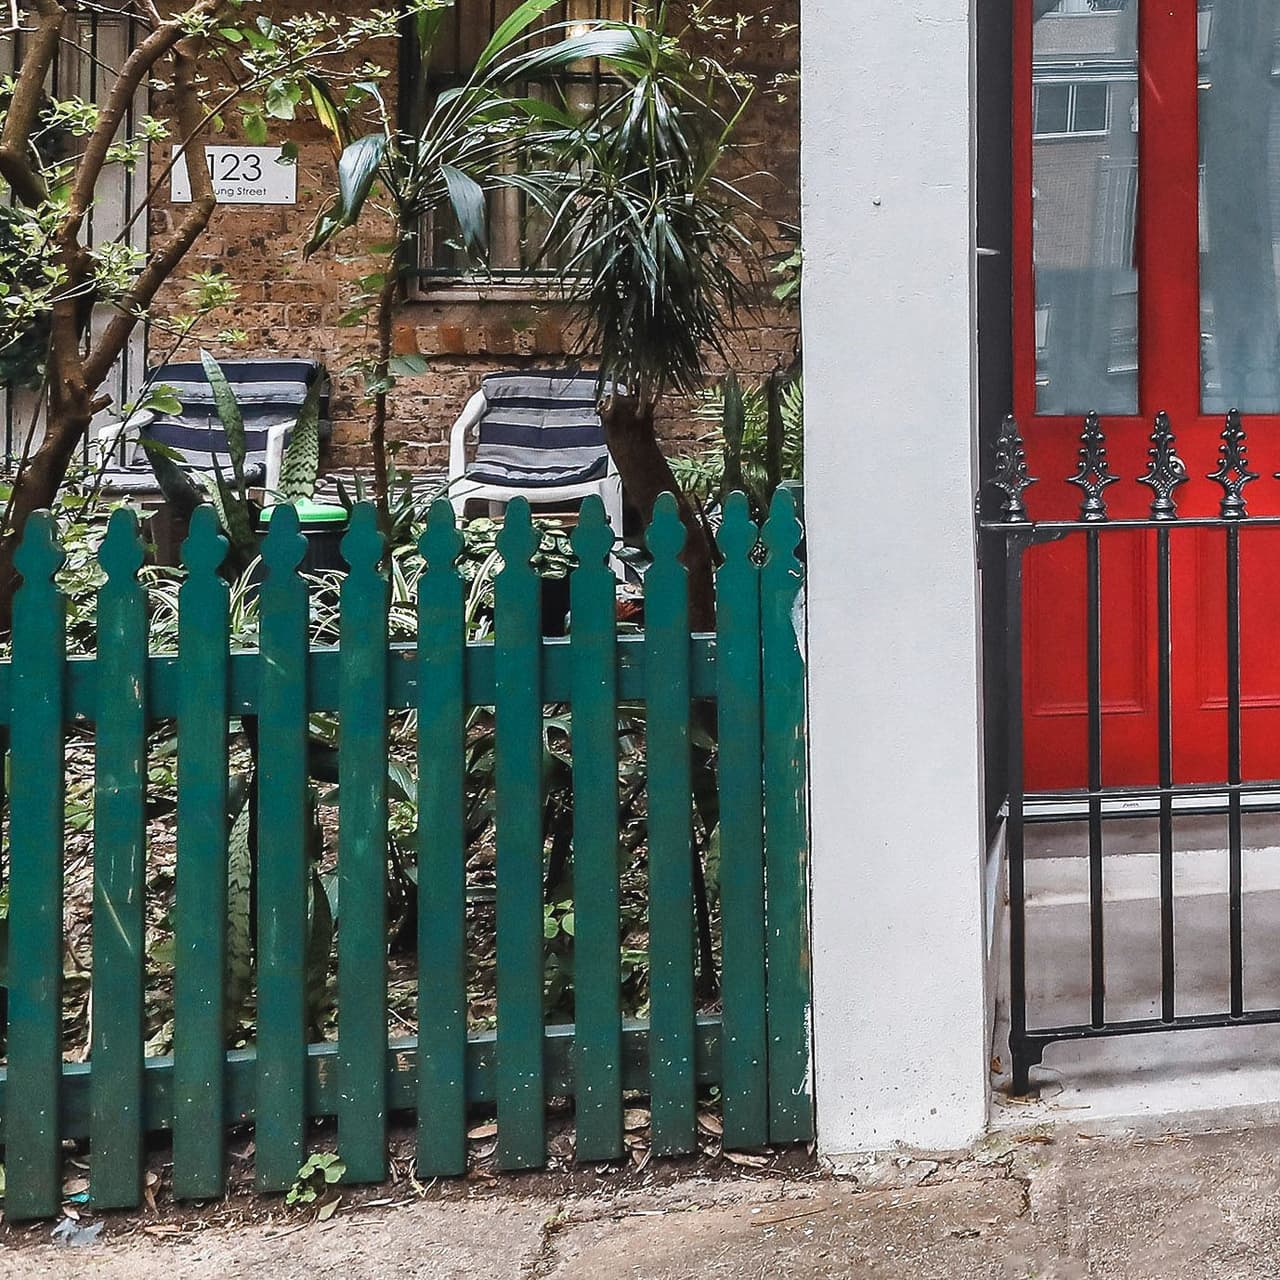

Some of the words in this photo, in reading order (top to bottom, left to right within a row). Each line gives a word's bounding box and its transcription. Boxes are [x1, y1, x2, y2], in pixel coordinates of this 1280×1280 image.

[207, 153, 262, 181] 123
[215, 188, 234, 198] ung
[237, 186, 266, 195] Street
